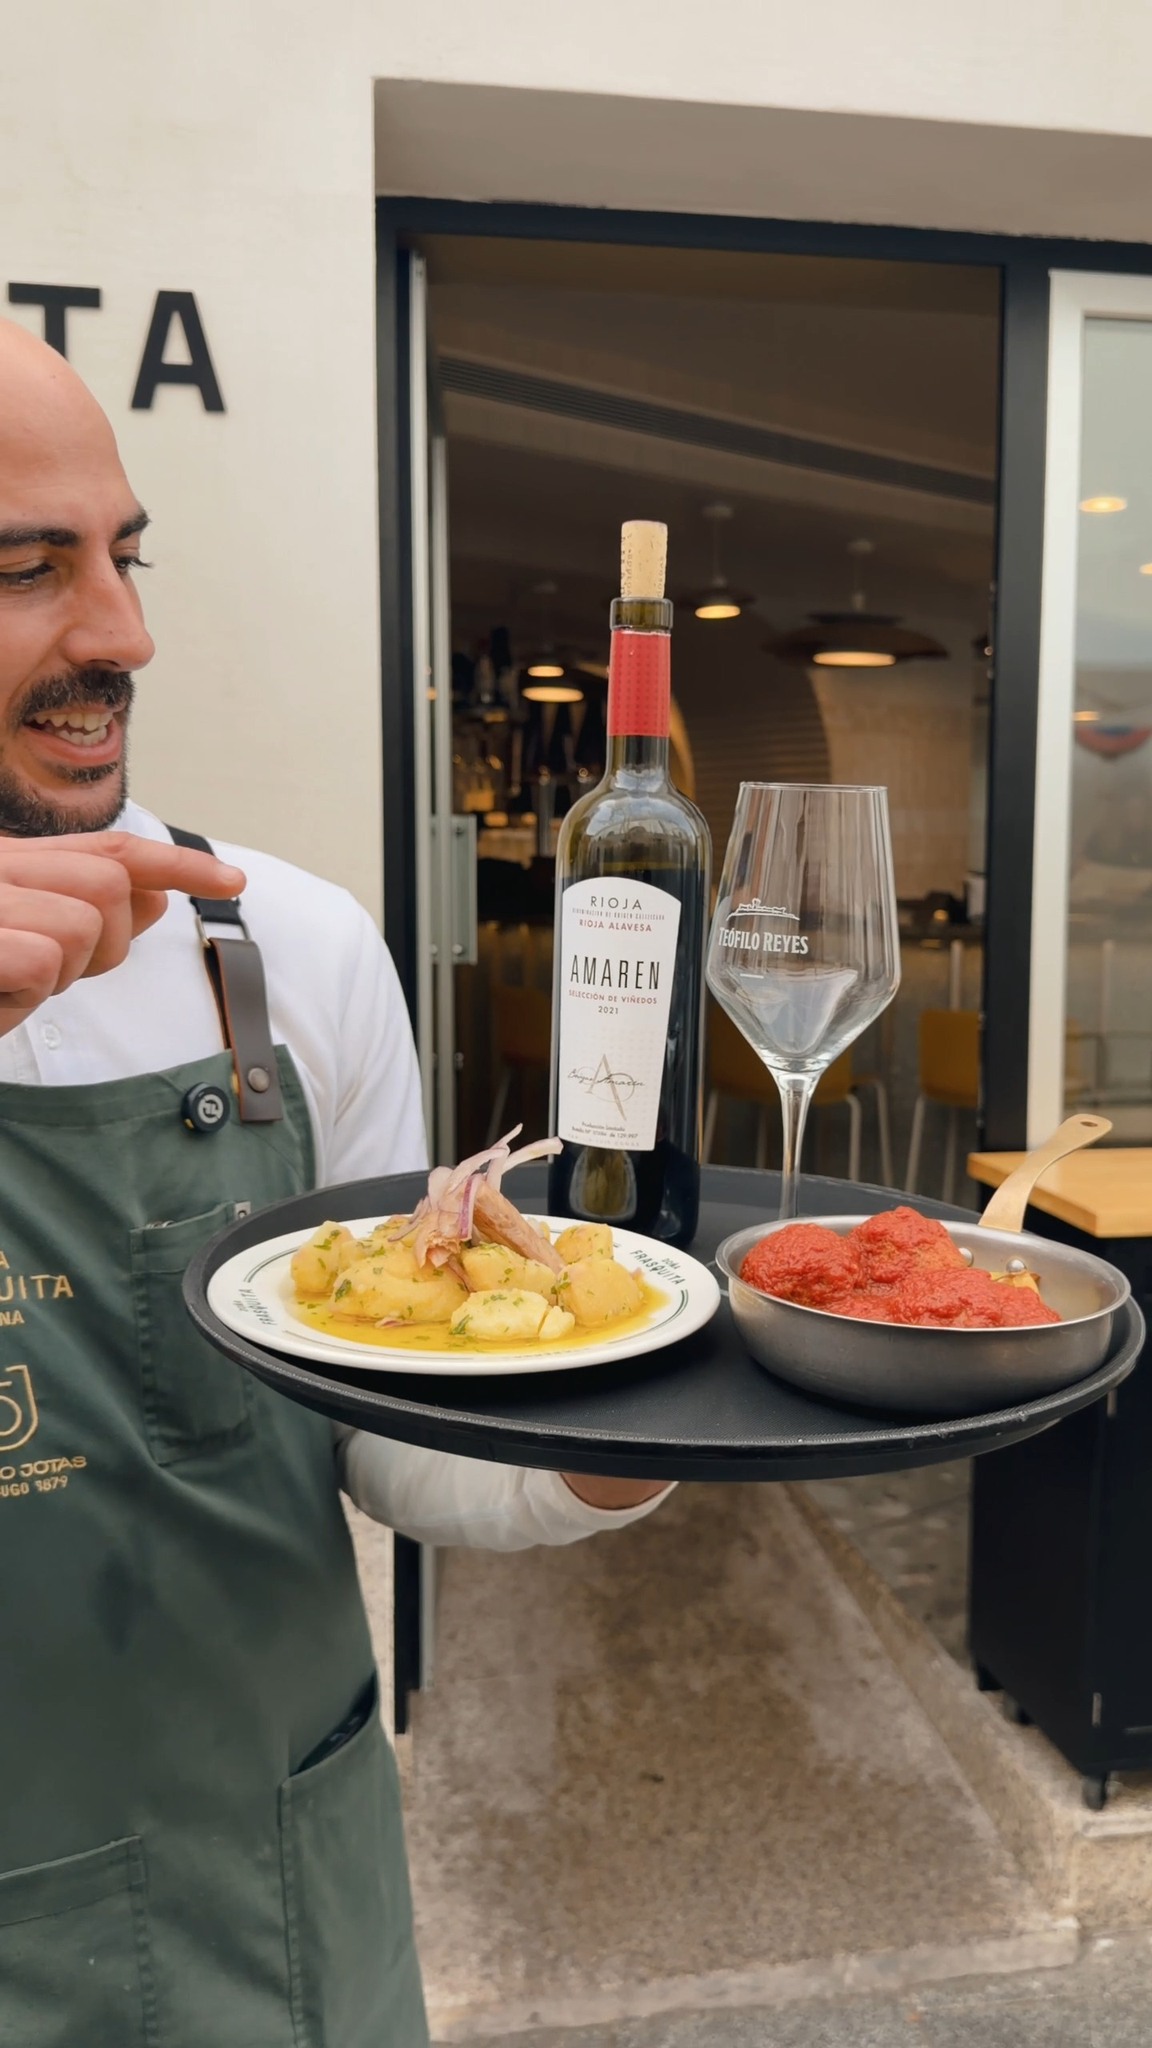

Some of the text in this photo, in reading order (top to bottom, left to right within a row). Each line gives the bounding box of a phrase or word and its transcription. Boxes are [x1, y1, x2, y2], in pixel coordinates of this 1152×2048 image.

[590, 895, 642, 910] RIOJA
[579, 919, 652, 932] RIOJA ALAVESA
[718, 927, 809, 955] TEÓFILO REYES
[570, 954, 660, 990] AMAREN
[568, 989, 657, 1004] SELECCIÓN DE VIÑEDOS
[598, 1005, 619, 1015] 2021
[630, 1249, 686, 1285] FRASQUITA
[20, 1456, 87, 1477] JOTAS
[0, 1475, 68, 1498] UGO 1879
